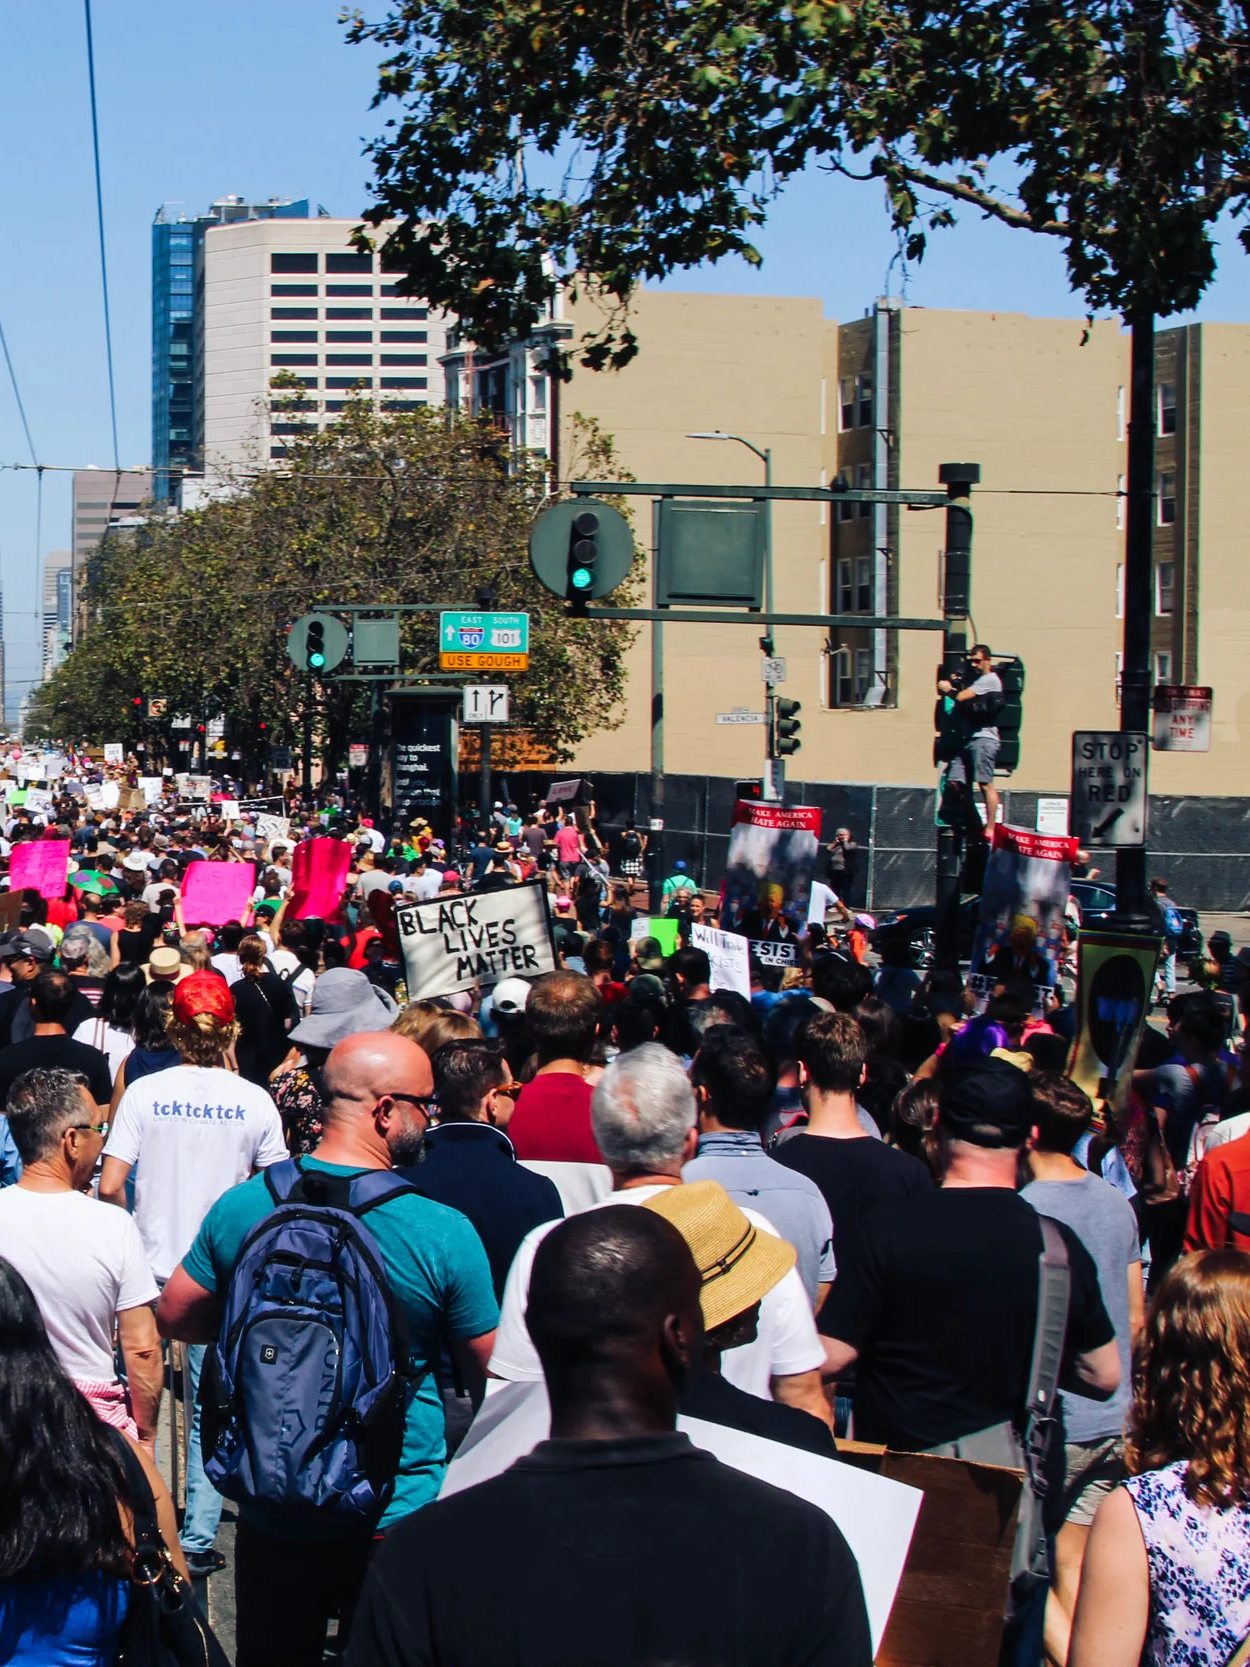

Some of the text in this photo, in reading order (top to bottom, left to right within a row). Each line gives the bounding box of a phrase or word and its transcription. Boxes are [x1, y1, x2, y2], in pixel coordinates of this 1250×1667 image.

[461, 616, 483, 624] EAST
[462, 633, 515, 645] 80 101
[447, 655, 521, 667] USE GOUGH
[1172, 714, 1195, 725] ANY
[1169, 727, 1195, 739] TIME
[407, 743, 441, 752] quickest
[1082, 742, 1138, 760] STOP
[409, 754, 419, 762] to
[1078, 767, 1142, 778] HERE ON
[1088, 785, 1131, 802] RED
[750, 808, 813, 819] MAKE AMERICA
[752, 816, 807, 829] HATE AGAIN
[1034, 839, 1069, 849] AMERICA
[1035, 849, 1062, 859] AGAIN
[400, 898, 479, 936] BLACK
[444, 918, 517, 954] LIVES
[749, 940, 799, 960] ESIS
[457, 944, 540, 981] MATTER
[189, 1118, 216, 1126] CLIMATE
[219, 1120, 245, 1128] ACTION
[314, 1338, 339, 1433] RINO
